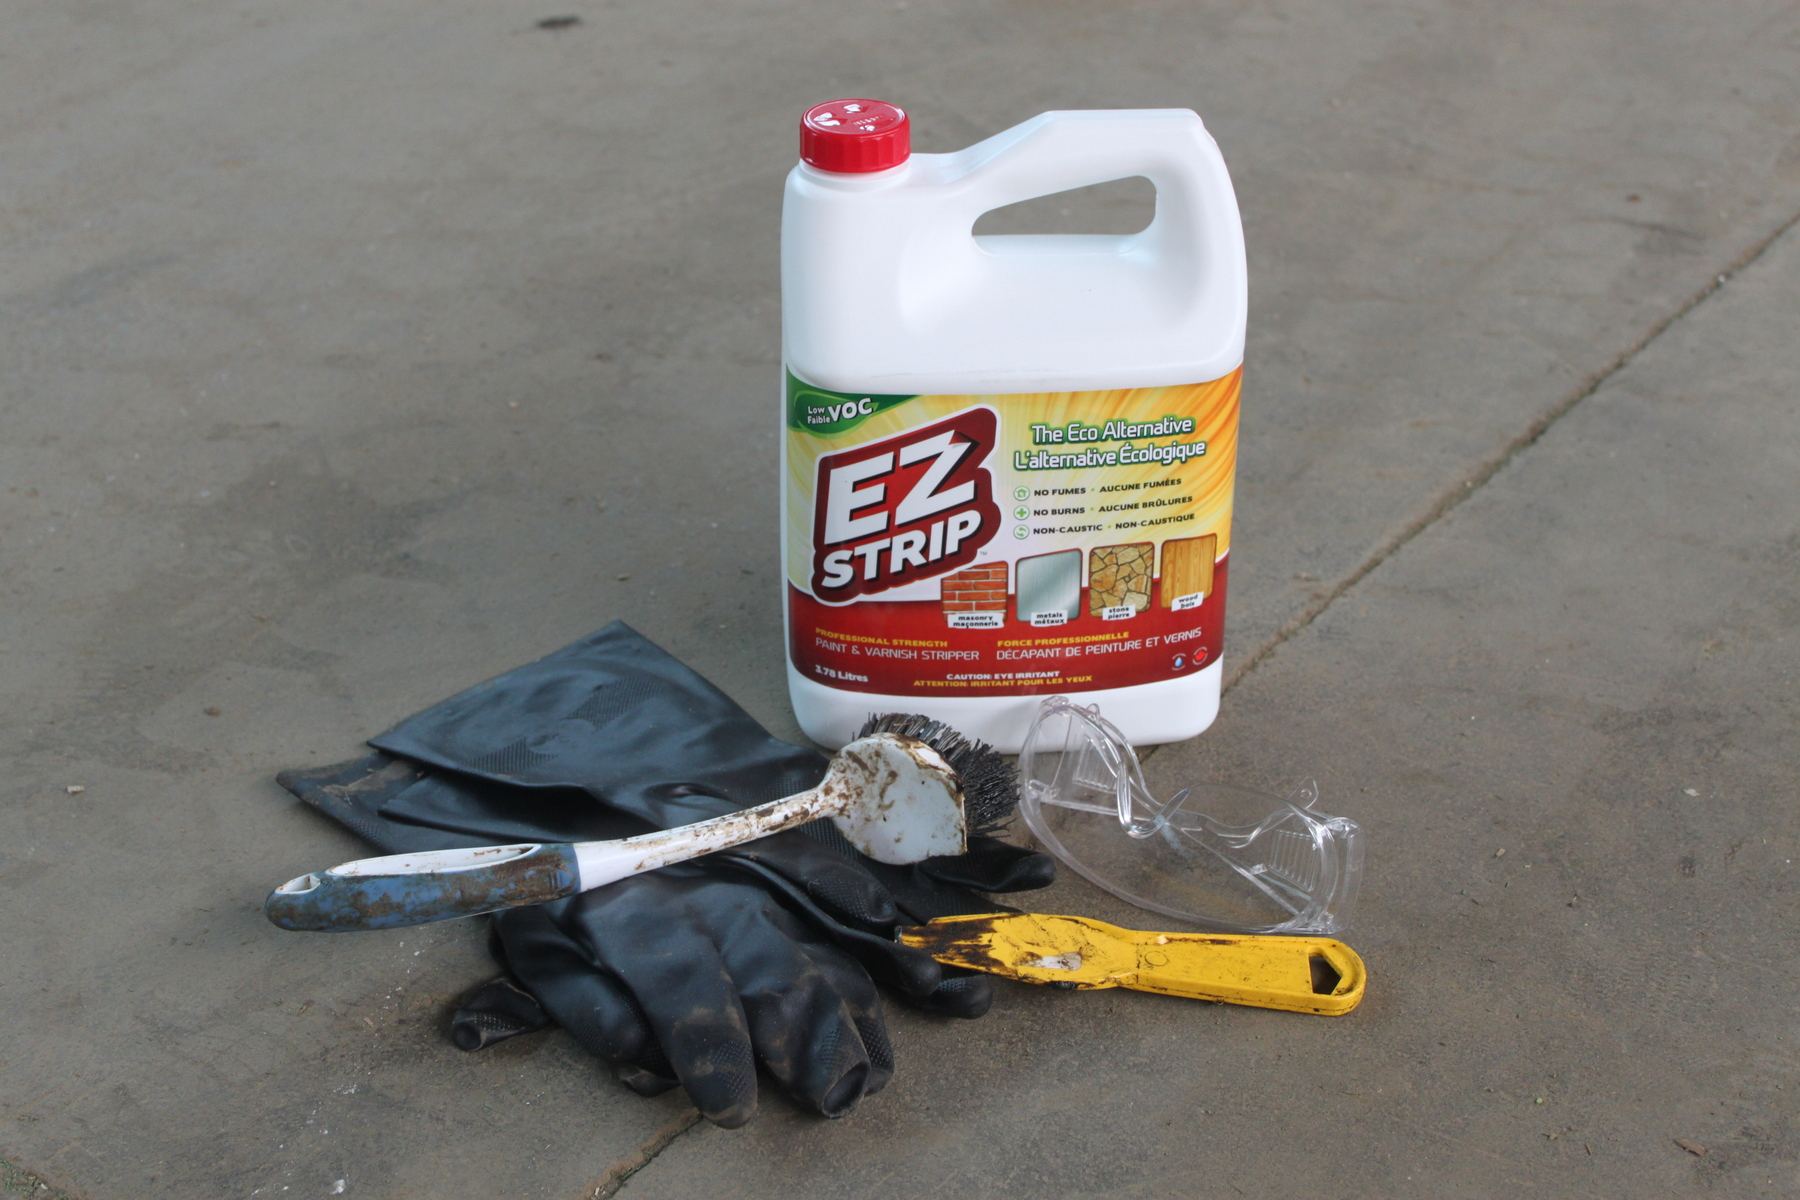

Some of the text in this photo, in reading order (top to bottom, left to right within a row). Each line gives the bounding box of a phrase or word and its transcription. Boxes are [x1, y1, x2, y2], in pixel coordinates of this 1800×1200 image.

[808, 406, 825, 414] Low
[828, 397, 873, 422] VOC
[807, 416, 831, 424] Faible
[1032, 417, 1192, 443] The Eco Alternative
[1015, 442, 1206, 469] L'alternative Écologique
[824, 430, 976, 545] EZ
[1052, 487, 1086, 496] FUMES
[1099, 483, 1141, 493] AUCUNE
[1143, 478, 1182, 489] FUMÉES
[1051, 507, 1086, 515] BURNS
[1098, 503, 1140, 513] AUCUNE
[1142, 496, 1193, 509] BRÛLURES
[1033, 513, 1196, 535] NON-CAUSTIC NON-CAUSTIQUE
[821, 509, 983, 588] STRIP
[952, 620, 999, 629] maçonnerie
[1107, 612, 1130, 620] pierre
[815, 627, 948, 648] PROFESSIONAL STRENGTH
[996, 627, 1203, 660] DÉCAPANT DE PEINTURE ET VERNIS
[997, 632, 1130, 648] FORCE PROFESSIONNELLE
[815, 637, 980, 661] PAINT & VARNISH STRIPPER
[815, 664, 869, 683] 3.78 Litres
[946, 673, 992, 681] CAUTION:
[1015, 670, 1061, 679] IRRITANT
[970, 679, 1014, 687] IRRITANT
[1017, 678, 1044, 686] POUR
[1065, 675, 1093, 683] YEUX
